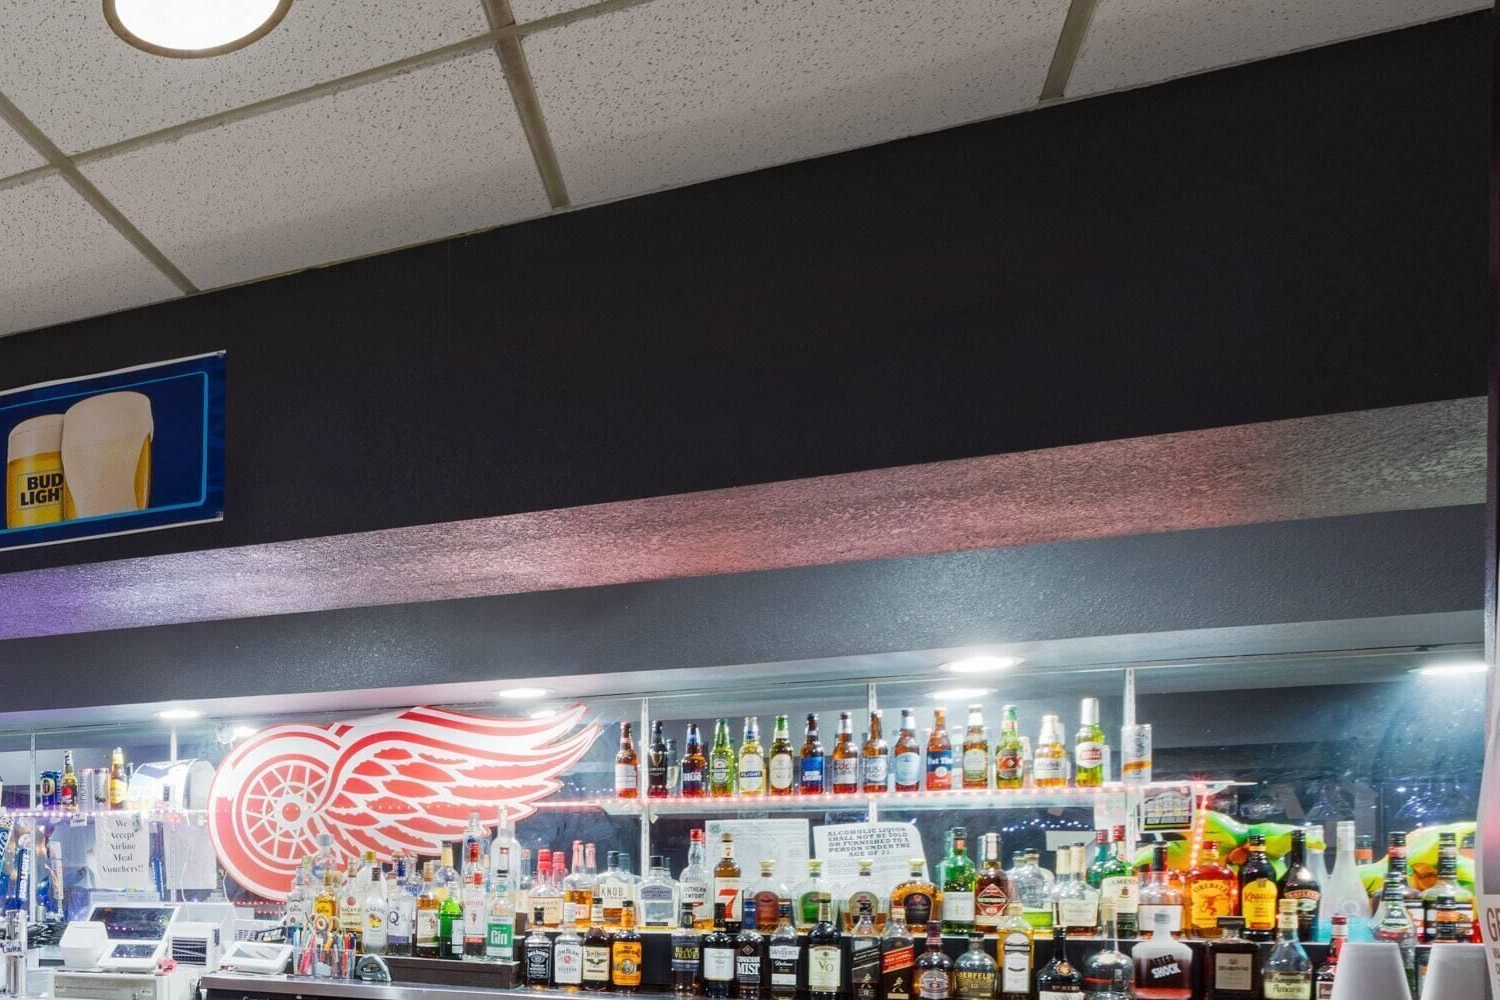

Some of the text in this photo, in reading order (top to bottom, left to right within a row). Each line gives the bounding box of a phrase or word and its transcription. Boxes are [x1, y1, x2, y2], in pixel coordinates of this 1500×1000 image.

[27, 473, 64, 490] BUD
[20, 487, 64, 506] LIGH
[115, 819, 128, 827] We
[110, 832, 136, 841] Accept
[827, 828, 878, 837] ALCOHOLIC
[828, 835, 855, 843] SHALL
[843, 838, 891, 847] FURNISHED
[828, 845, 865, 854] PERSON
[865, 843, 894, 851] UNDER
[113, 853, 133, 861] Meal
[101, 864, 144, 873] Vouchers!!
[601, 887, 624, 897] KNOB
[718, 888, 740, 919] 7
[490, 929, 508, 945] Gin
[736, 963, 760, 975] MIST
[1151, 962, 1182, 979] SHOCK
